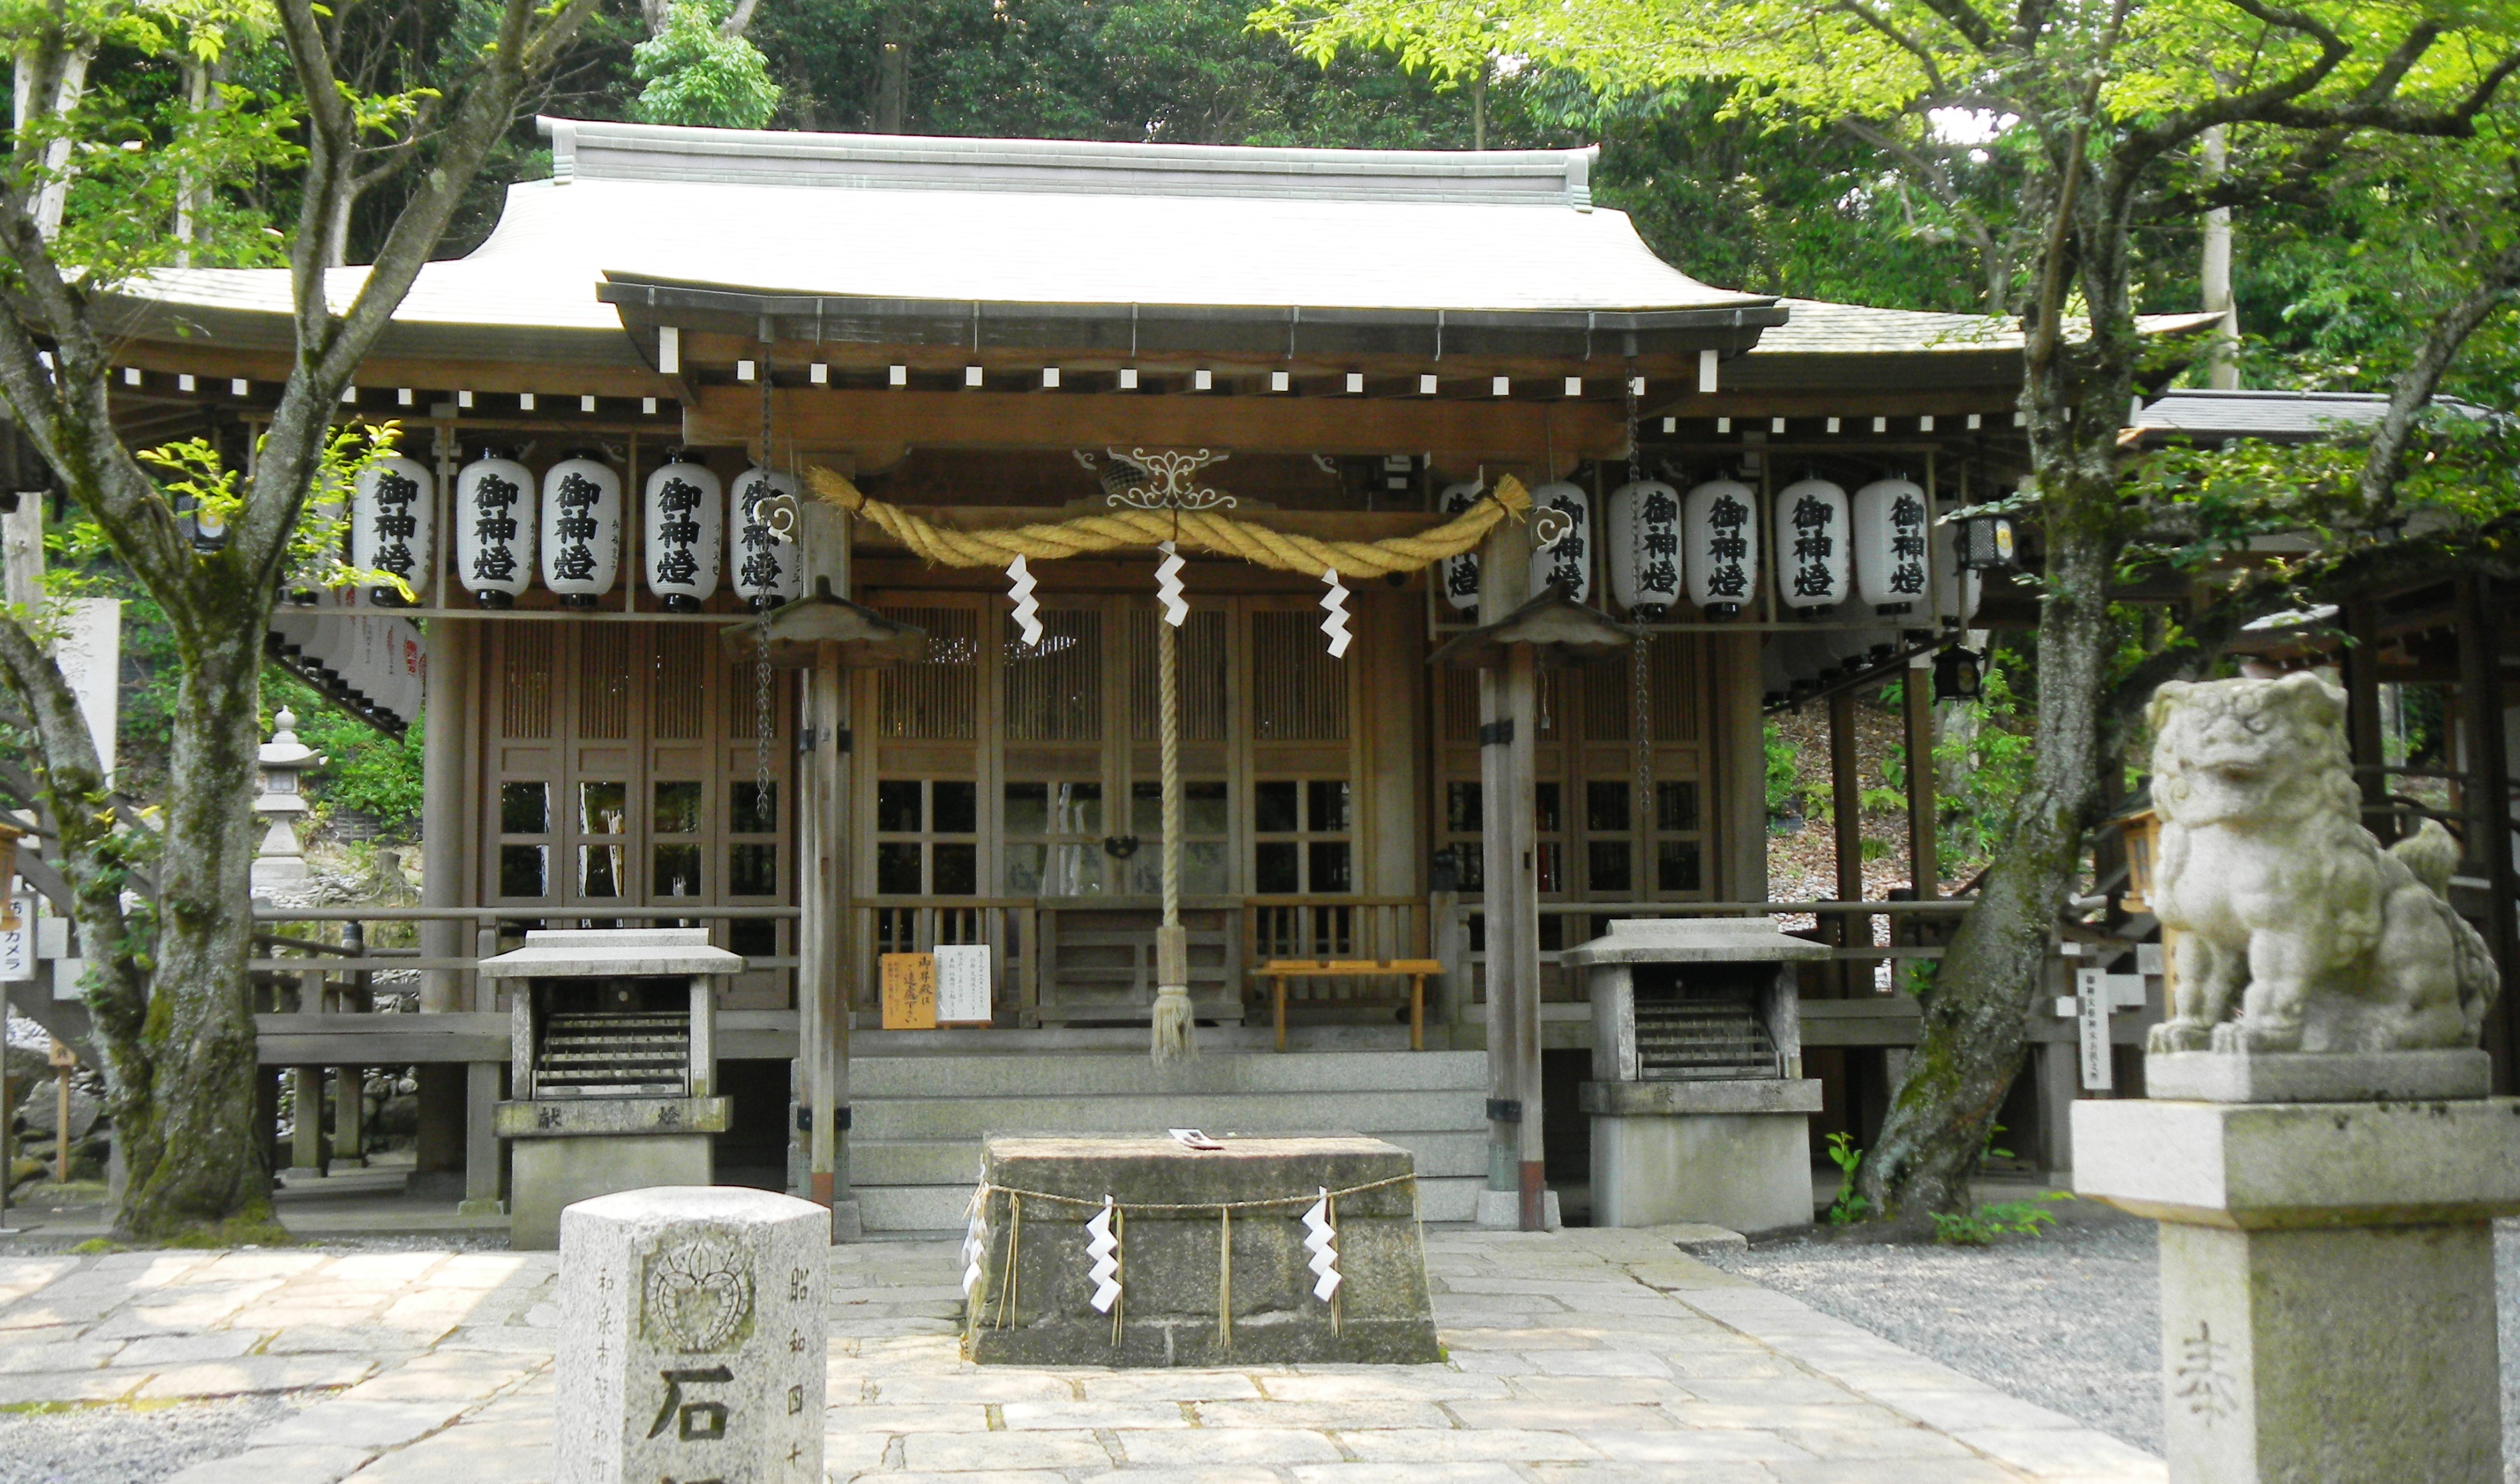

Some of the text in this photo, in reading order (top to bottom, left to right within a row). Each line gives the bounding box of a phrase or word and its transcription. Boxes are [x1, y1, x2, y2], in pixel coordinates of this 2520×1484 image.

[372, 469, 418, 581] 御神燈
[473, 473, 519, 582] 御神燈
[554, 472, 601, 581] 御神燈
[657, 477, 702, 586] 御神燈
[1641, 491, 1677, 596] 御神燈
[1707, 495, 1748, 597] 御神燈
[1791, 495, 1834, 597] 御神燈
[1889, 493, 1924, 595] 御神燈
[646, 1364, 735, 1484] 石
